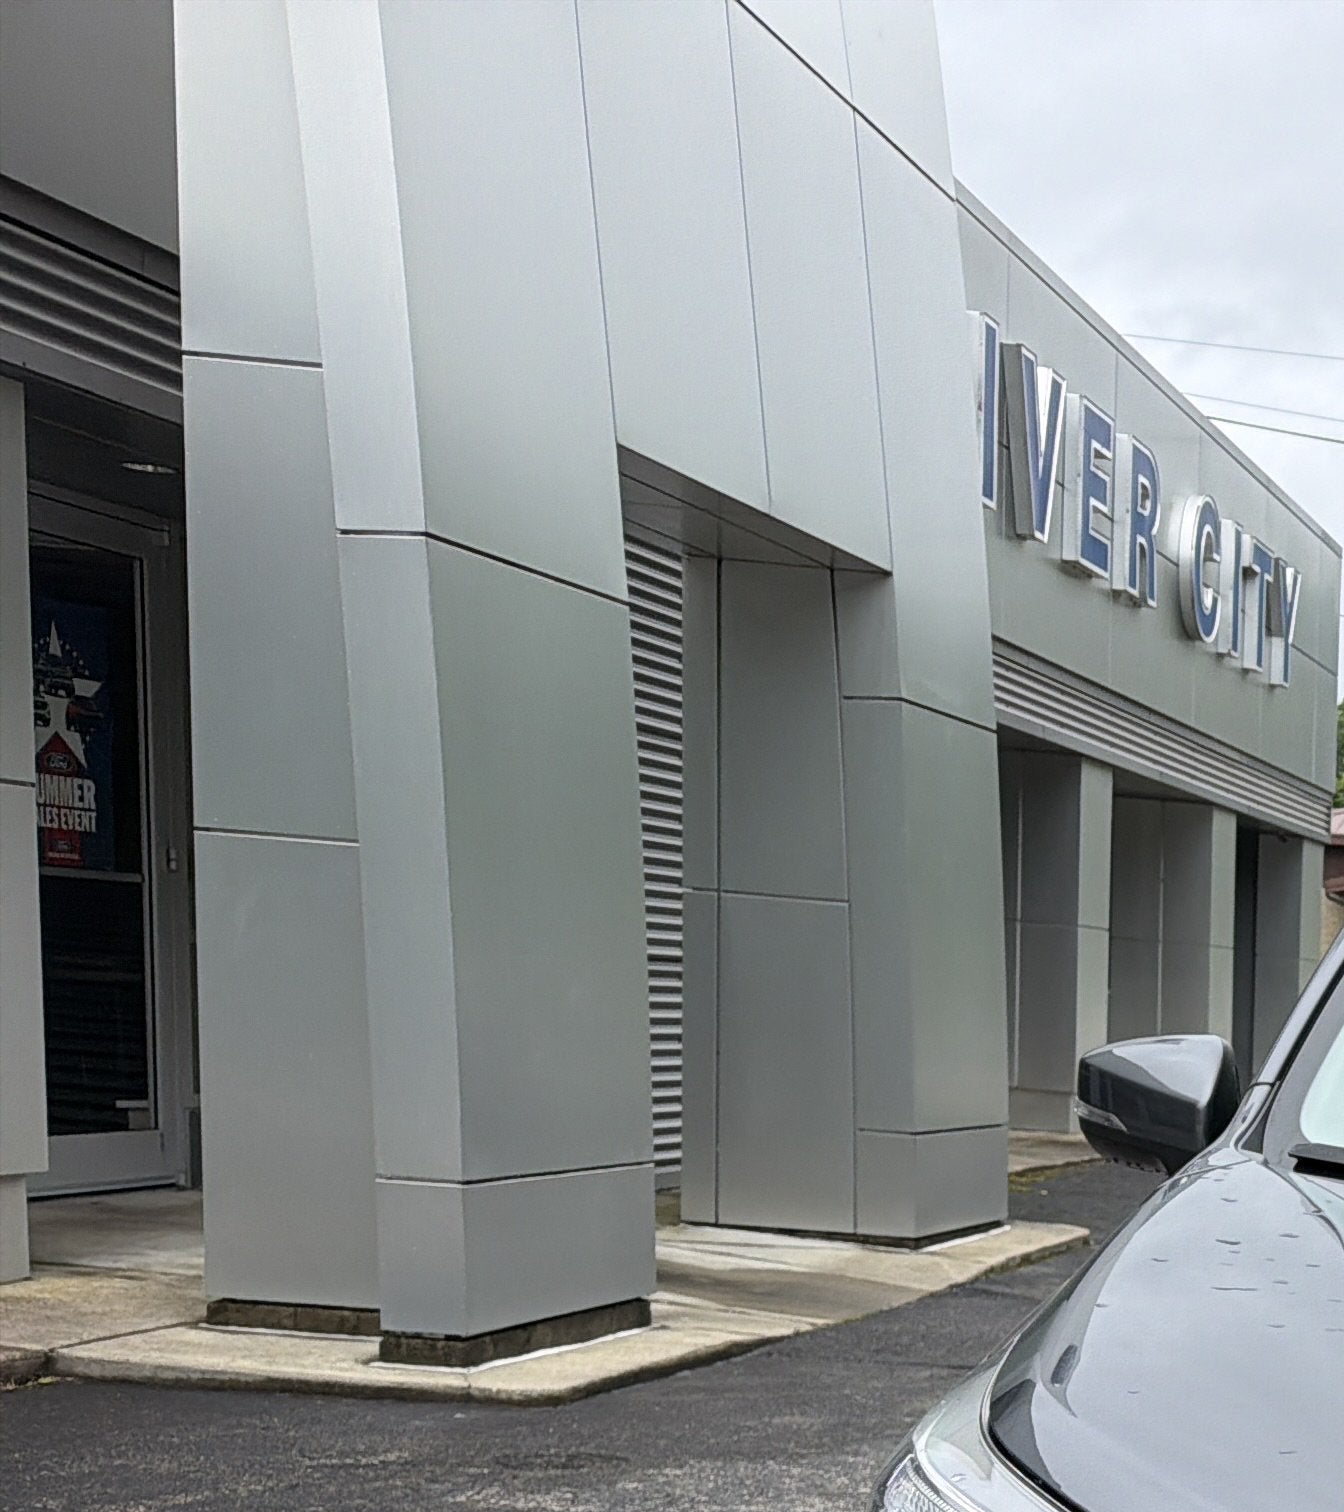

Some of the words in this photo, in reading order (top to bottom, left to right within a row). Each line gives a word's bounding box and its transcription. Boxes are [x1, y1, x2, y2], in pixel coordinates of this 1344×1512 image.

[970, 310, 1161, 608] IVER
[1179, 494, 1302, 688] CITY
[36, 772, 97, 811] UMMER
[36, 804, 59, 829] LES
[60, 809, 97, 834] EVENT
